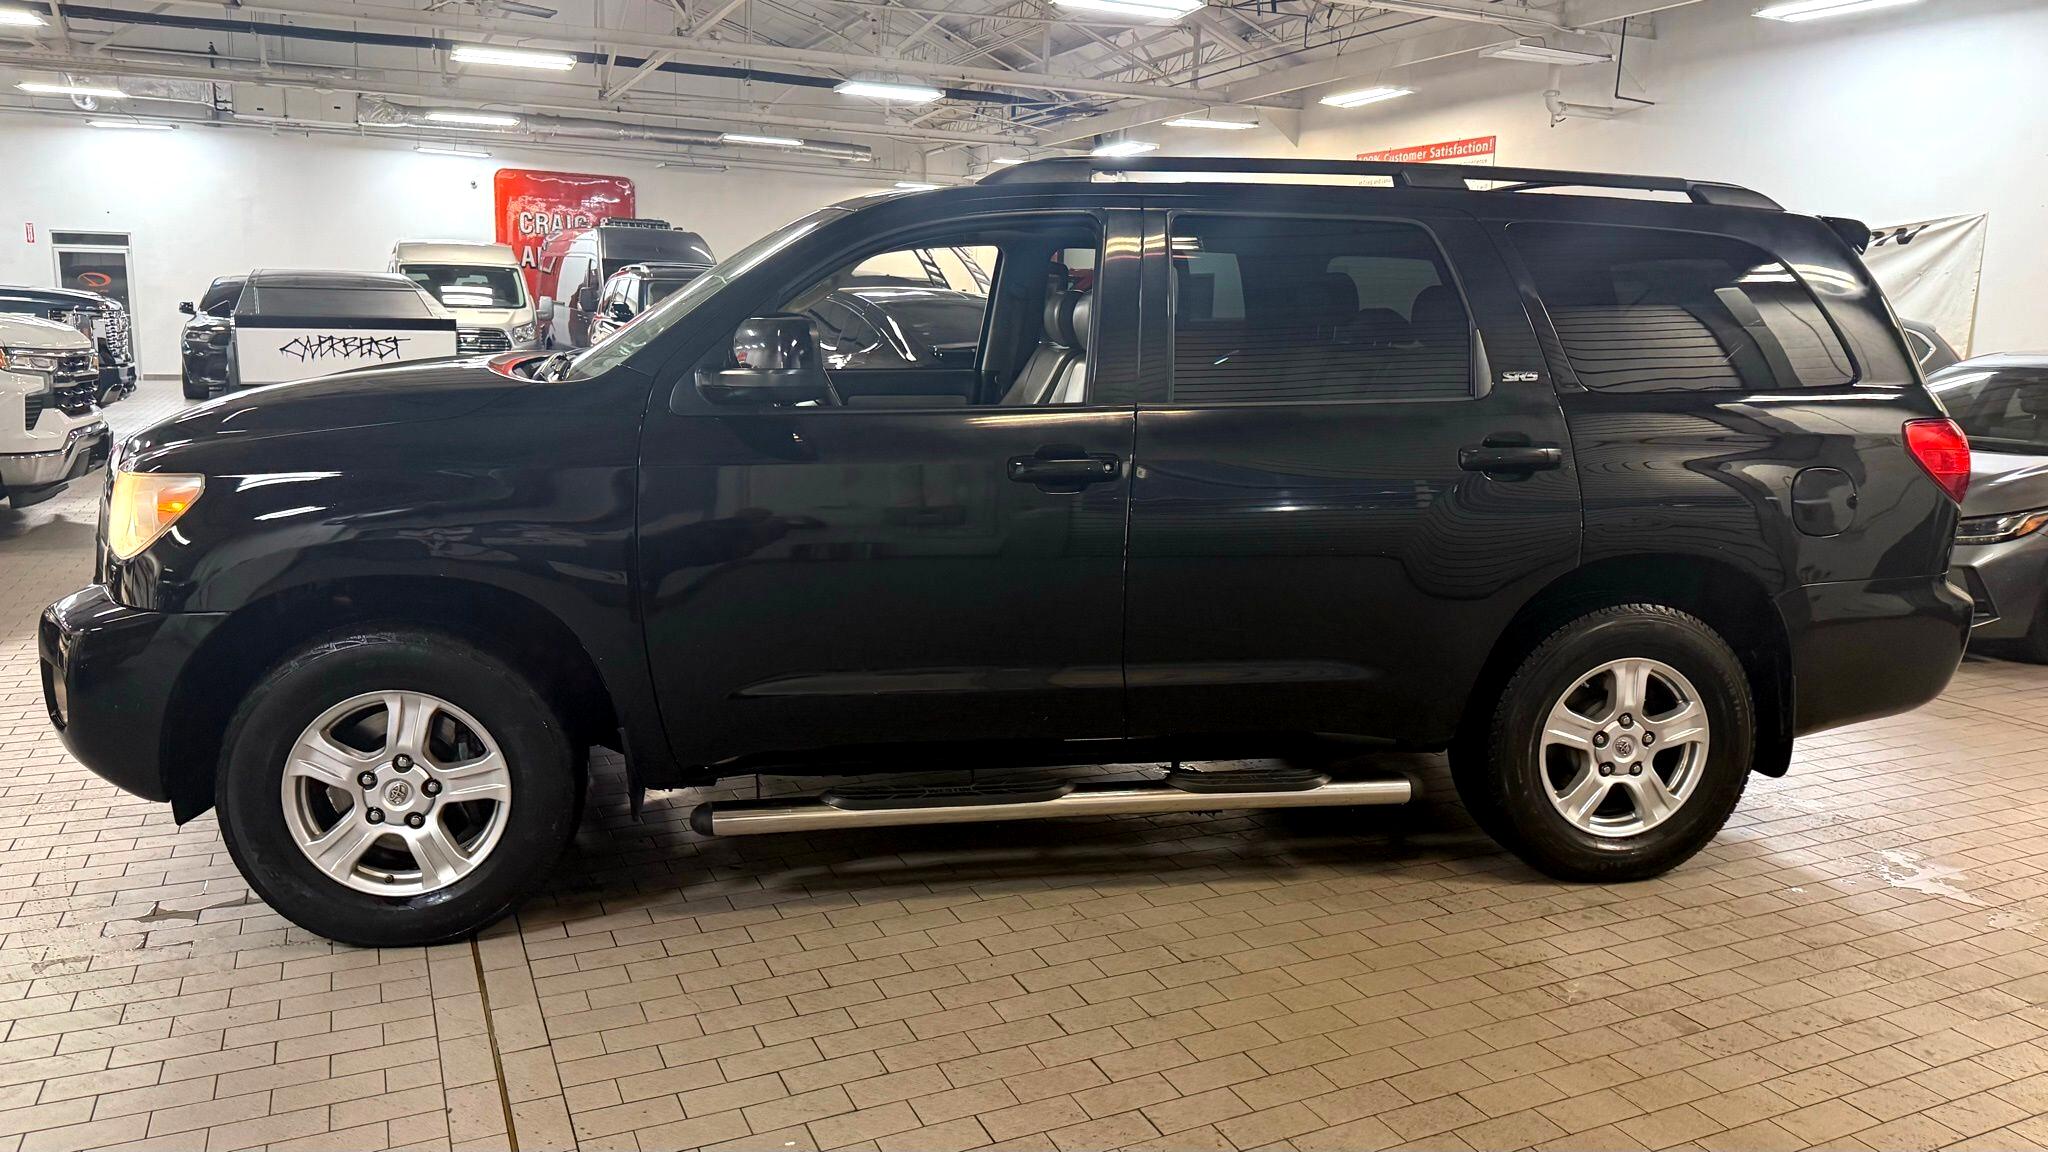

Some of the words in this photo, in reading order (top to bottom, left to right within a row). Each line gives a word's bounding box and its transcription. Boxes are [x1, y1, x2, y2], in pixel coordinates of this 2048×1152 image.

[1383, 150, 1427, 163] Customer
[1430, 138, 1493, 159] Satisfaction!
[1502, 371, 1539, 382] SR5
